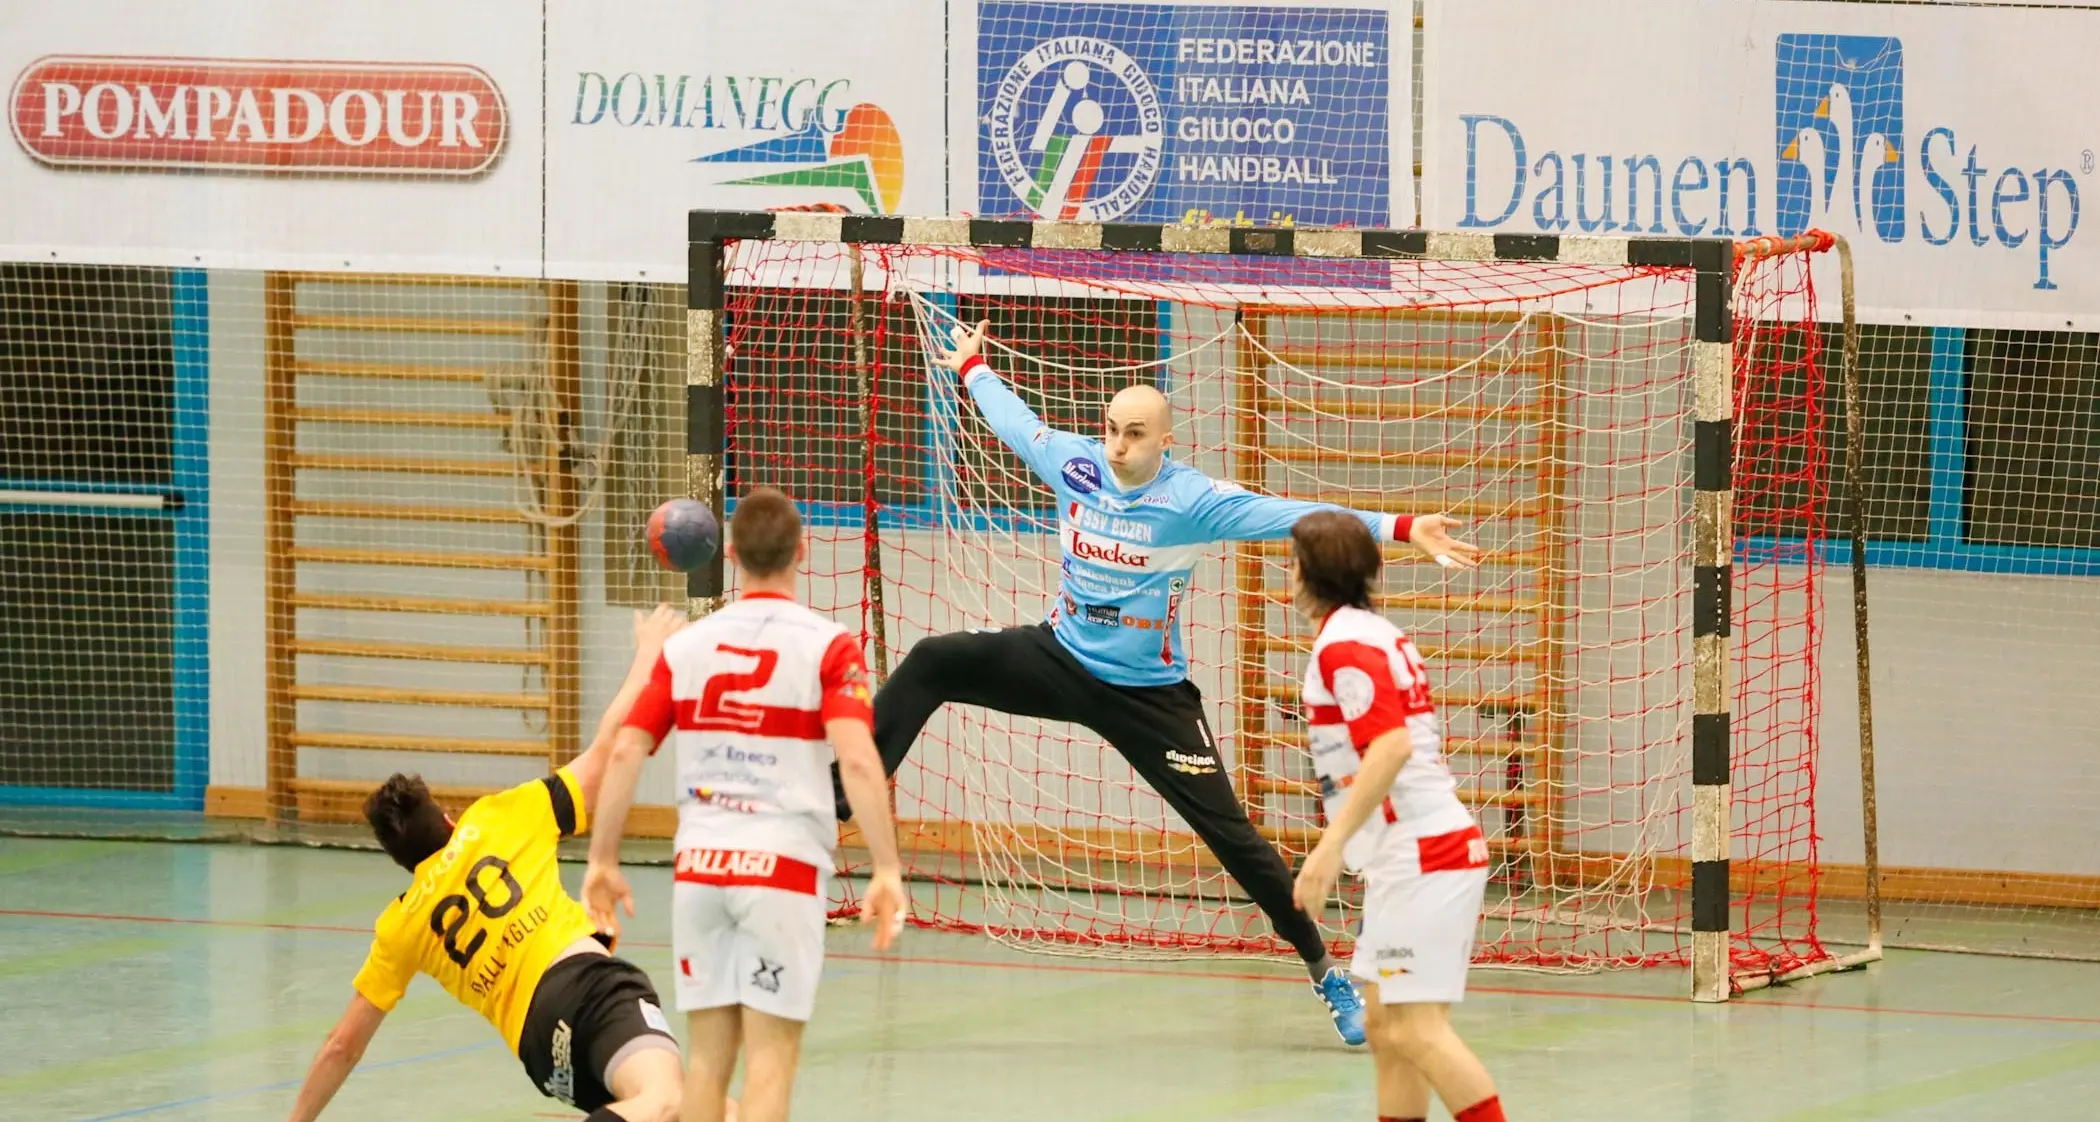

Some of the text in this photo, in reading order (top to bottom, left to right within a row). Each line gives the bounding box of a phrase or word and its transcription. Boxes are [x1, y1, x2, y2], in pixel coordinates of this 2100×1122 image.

[1178, 37, 1375, 68] FEDERAZIONE
[40, 80, 484, 149] POMPADOUR
[570, 71, 851, 134] DOMANEGG
[1178, 77, 1311, 105] ITALIANA
[994, 39, 1159, 216] FEDERAZIONE ITALIANA GIUOCO HANDBALL
[1178, 117, 1295, 144] GIUOCO
[1178, 156, 1339, 186] HANDBALL
[1456, 113, 1762, 237] Daunen
[1919, 126, 2081, 291] Step
[1067, 528, 1150, 568] Loacker
[1083, 508, 1152, 543] SSV BOZEN
[693, 643, 779, 728] 2
[430, 855, 524, 970] 20
